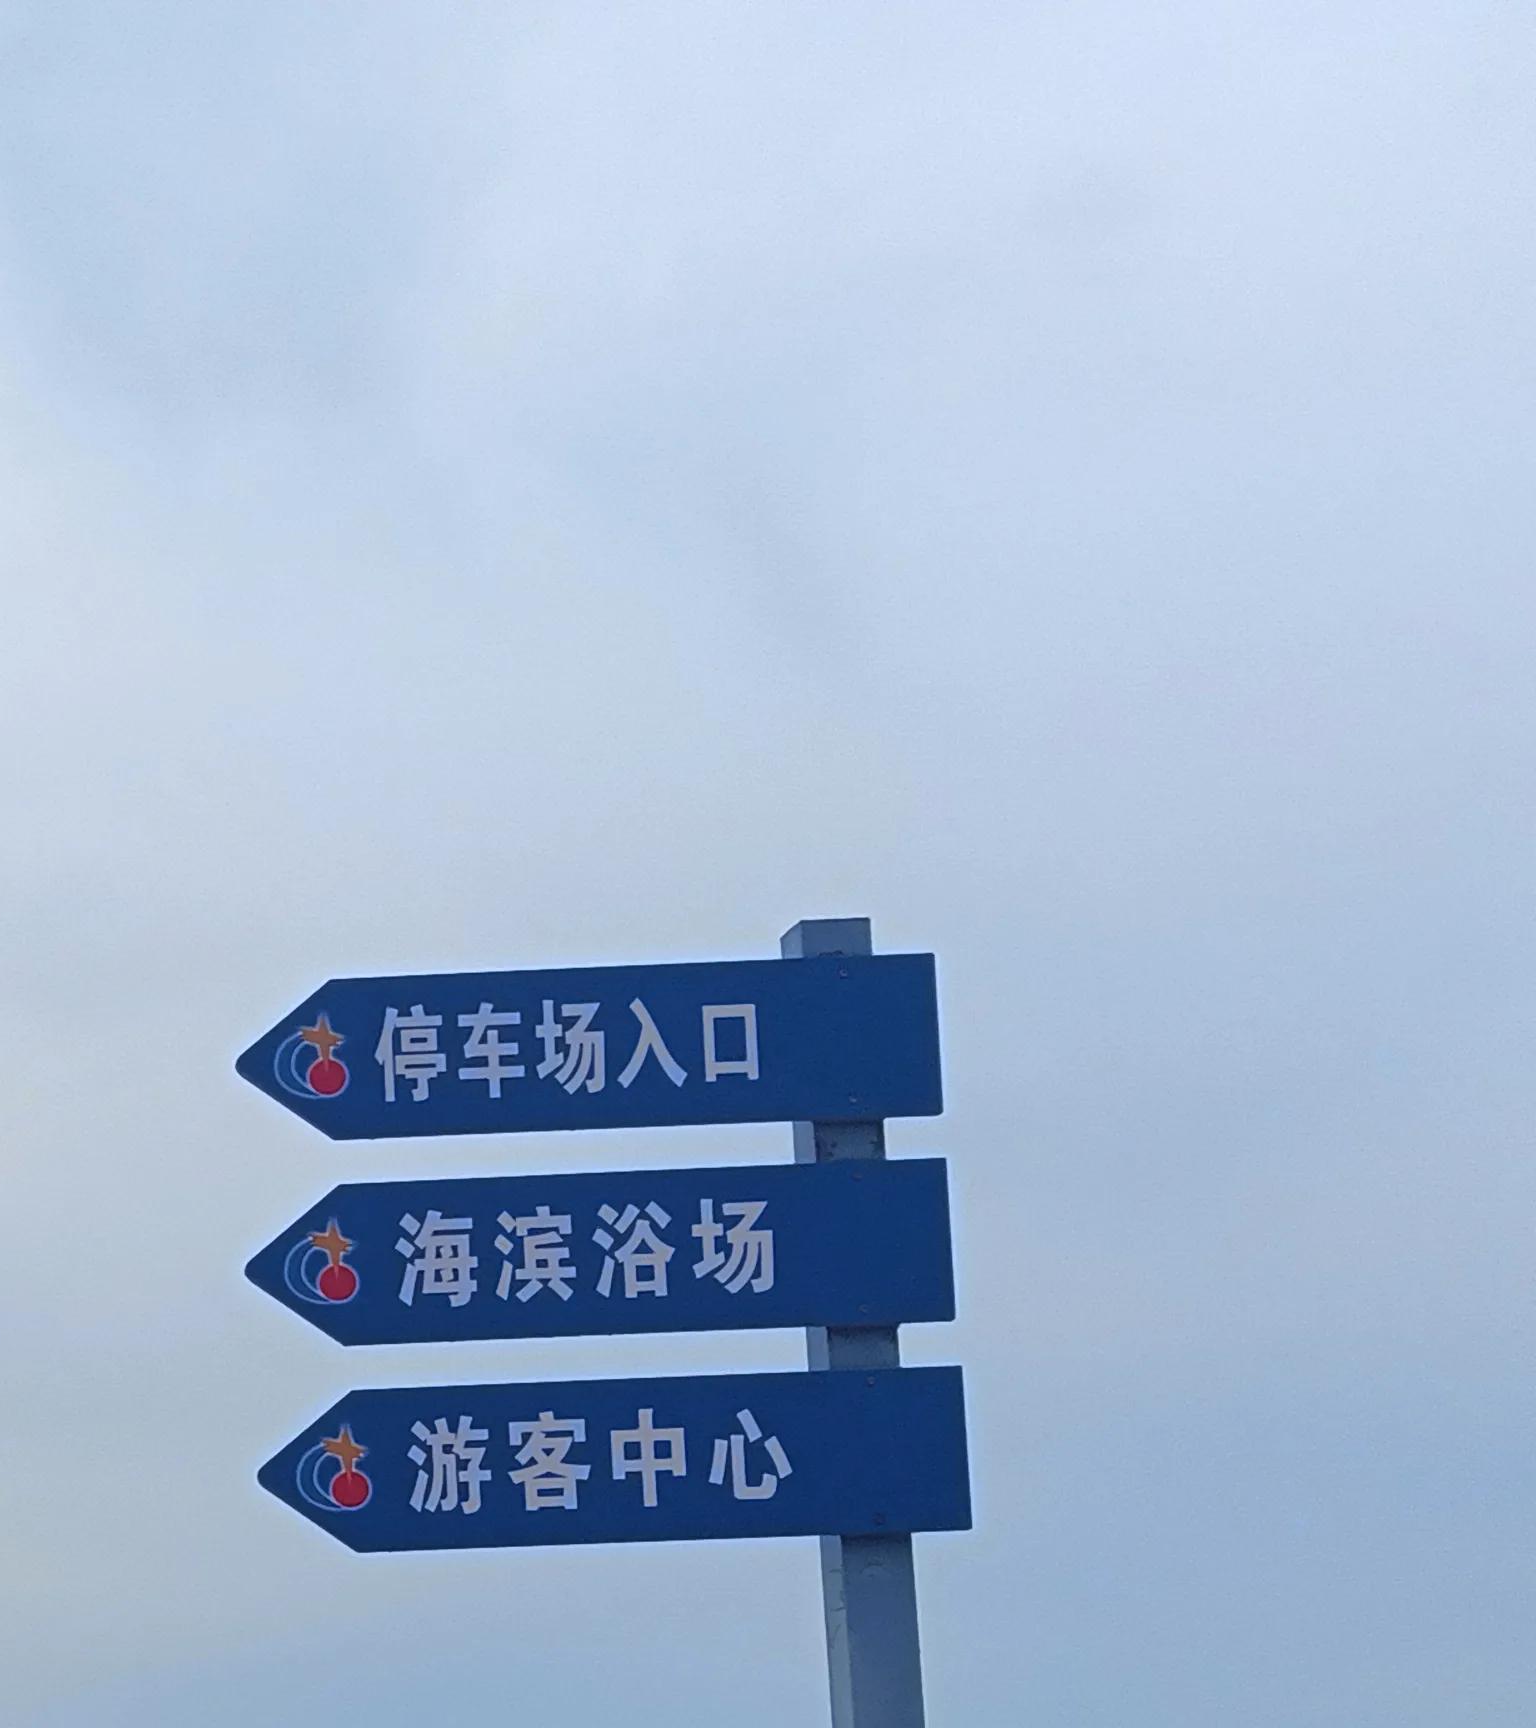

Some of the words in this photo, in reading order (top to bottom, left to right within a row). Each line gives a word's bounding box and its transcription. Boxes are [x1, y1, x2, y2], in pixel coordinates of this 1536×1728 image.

[374, 998, 761, 1102] 停车场入口
[395, 1198, 777, 1307] 海滨浴场
[407, 1409, 793, 1514] 游客中心
